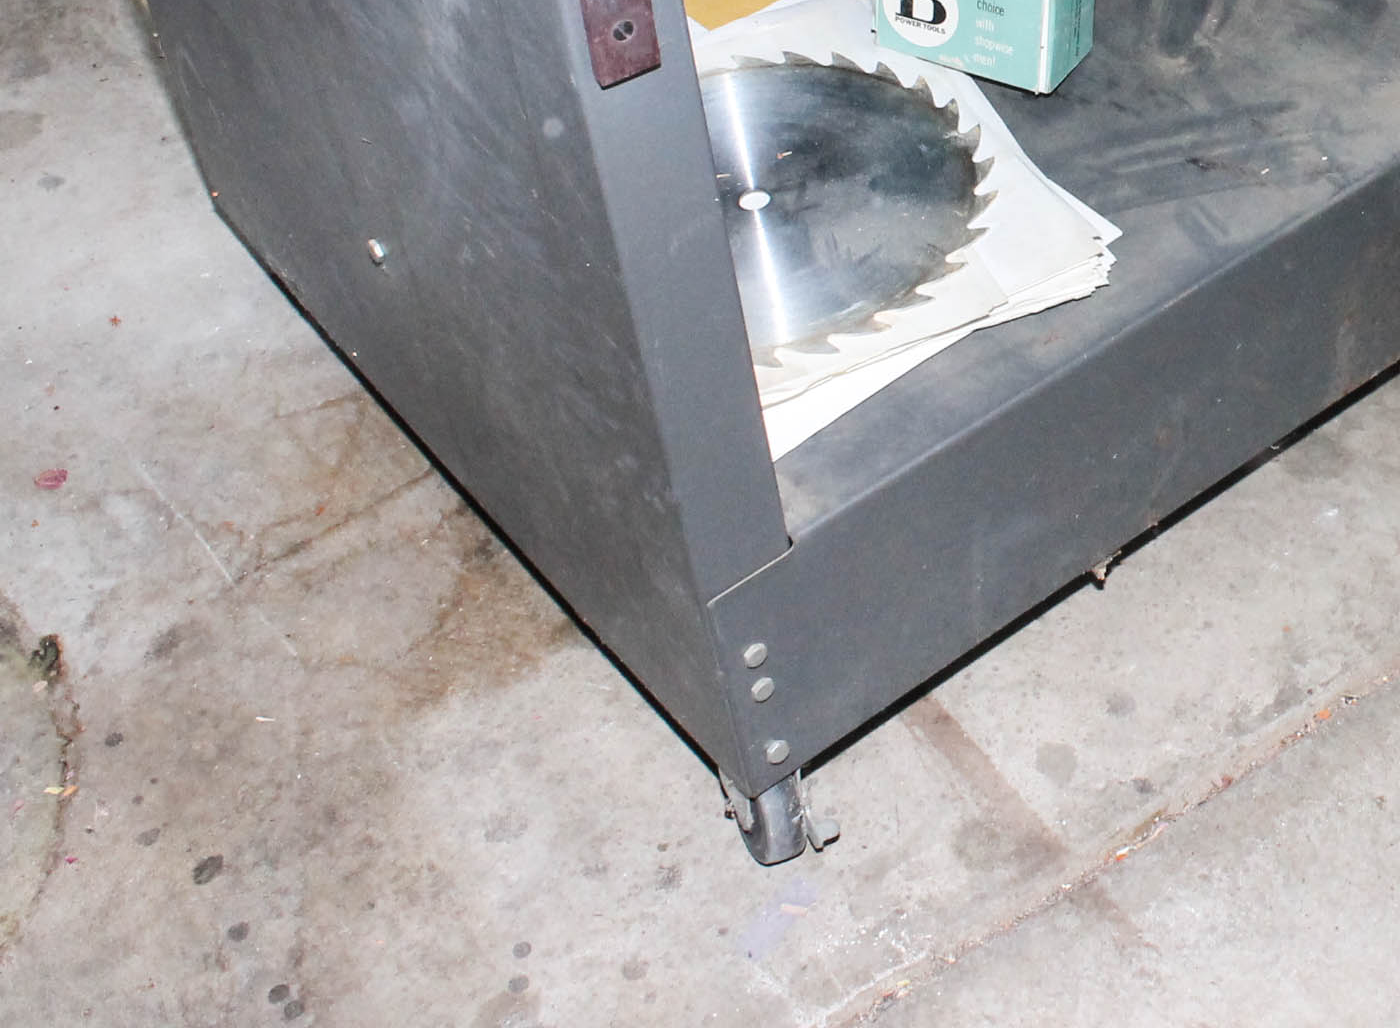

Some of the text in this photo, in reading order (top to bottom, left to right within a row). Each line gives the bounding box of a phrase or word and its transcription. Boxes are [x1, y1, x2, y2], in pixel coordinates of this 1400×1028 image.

[976, 0, 1005, 17] choice
[895, 15, 946, 35] POWER TOOLS
[975, 19, 995, 32] with
